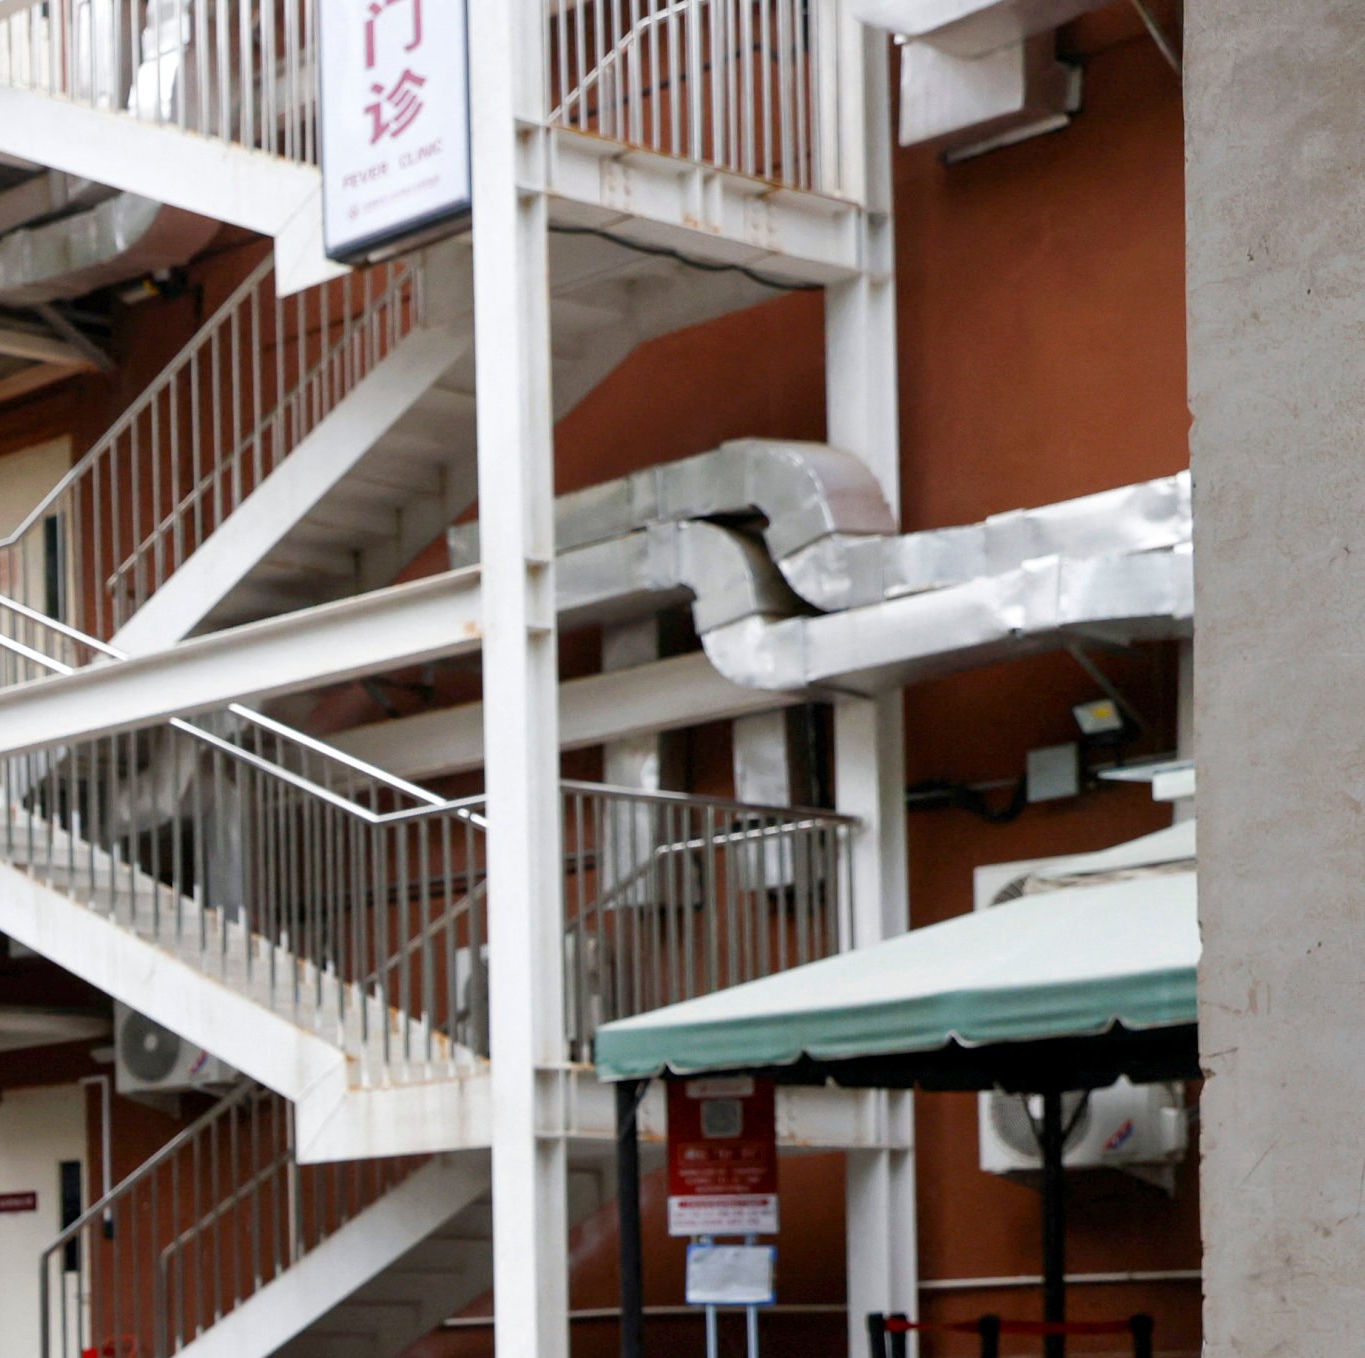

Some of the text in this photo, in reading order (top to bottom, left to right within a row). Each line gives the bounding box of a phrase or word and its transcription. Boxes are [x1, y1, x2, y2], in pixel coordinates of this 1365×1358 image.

[365, 0, 427, 144] 门诊
[342, 138, 444, 189] FEVER CLINIC
